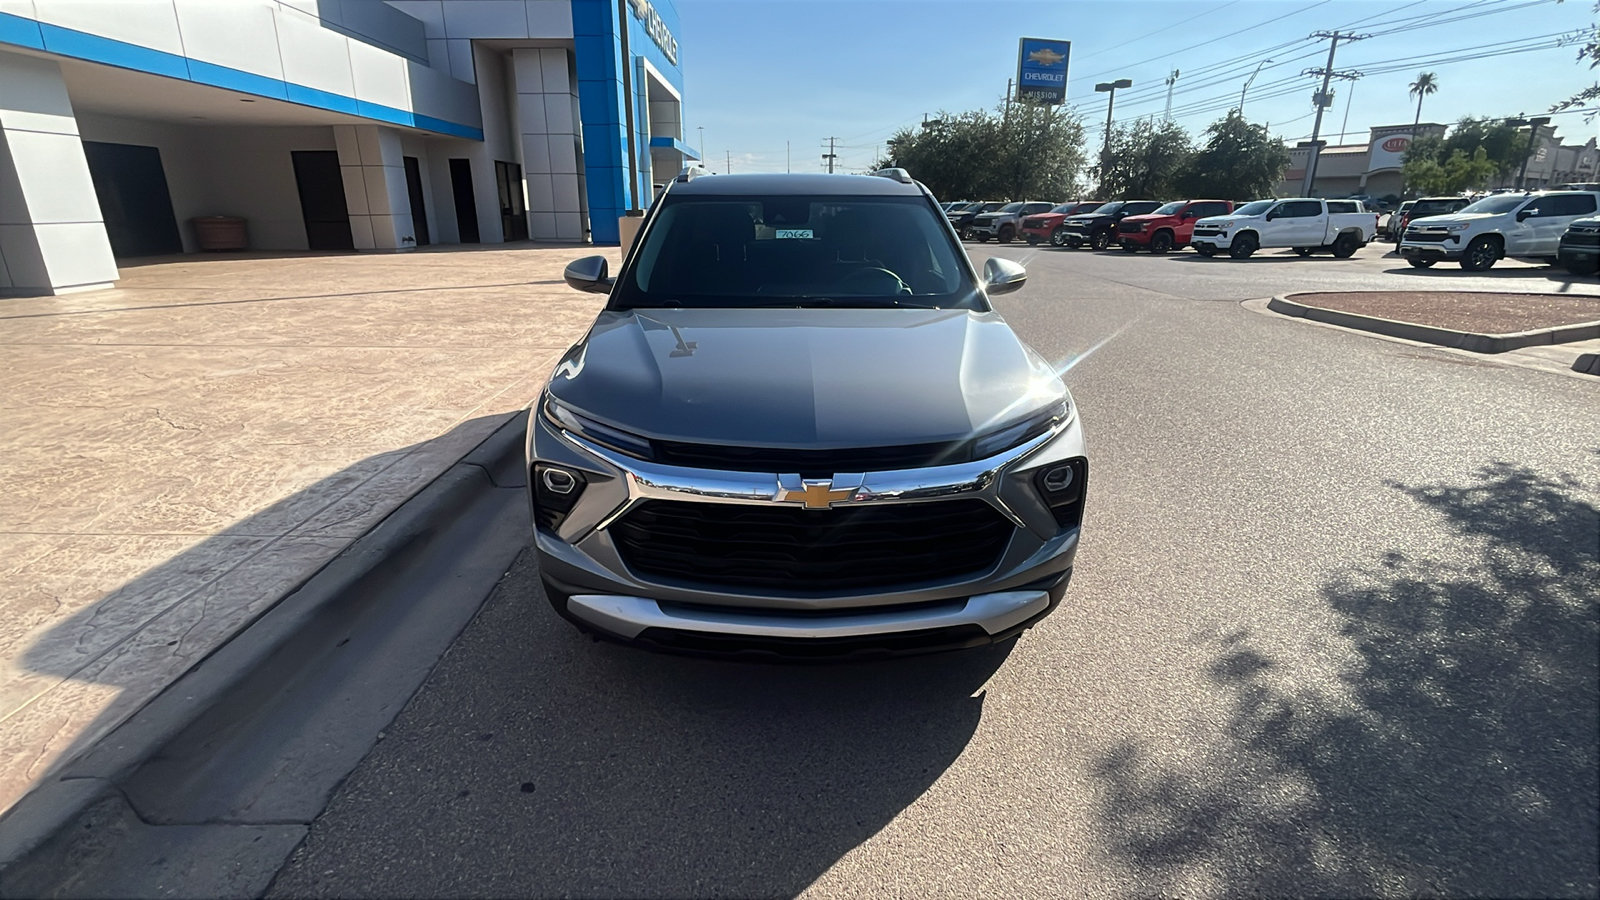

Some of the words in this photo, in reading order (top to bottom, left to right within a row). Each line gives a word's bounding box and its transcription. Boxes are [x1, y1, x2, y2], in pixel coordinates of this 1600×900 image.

[646, 0, 678, 65] CHEVROLET
[1024, 72, 1064, 82] CHEVROLET
[1028, 91, 1058, 99] MISSION
